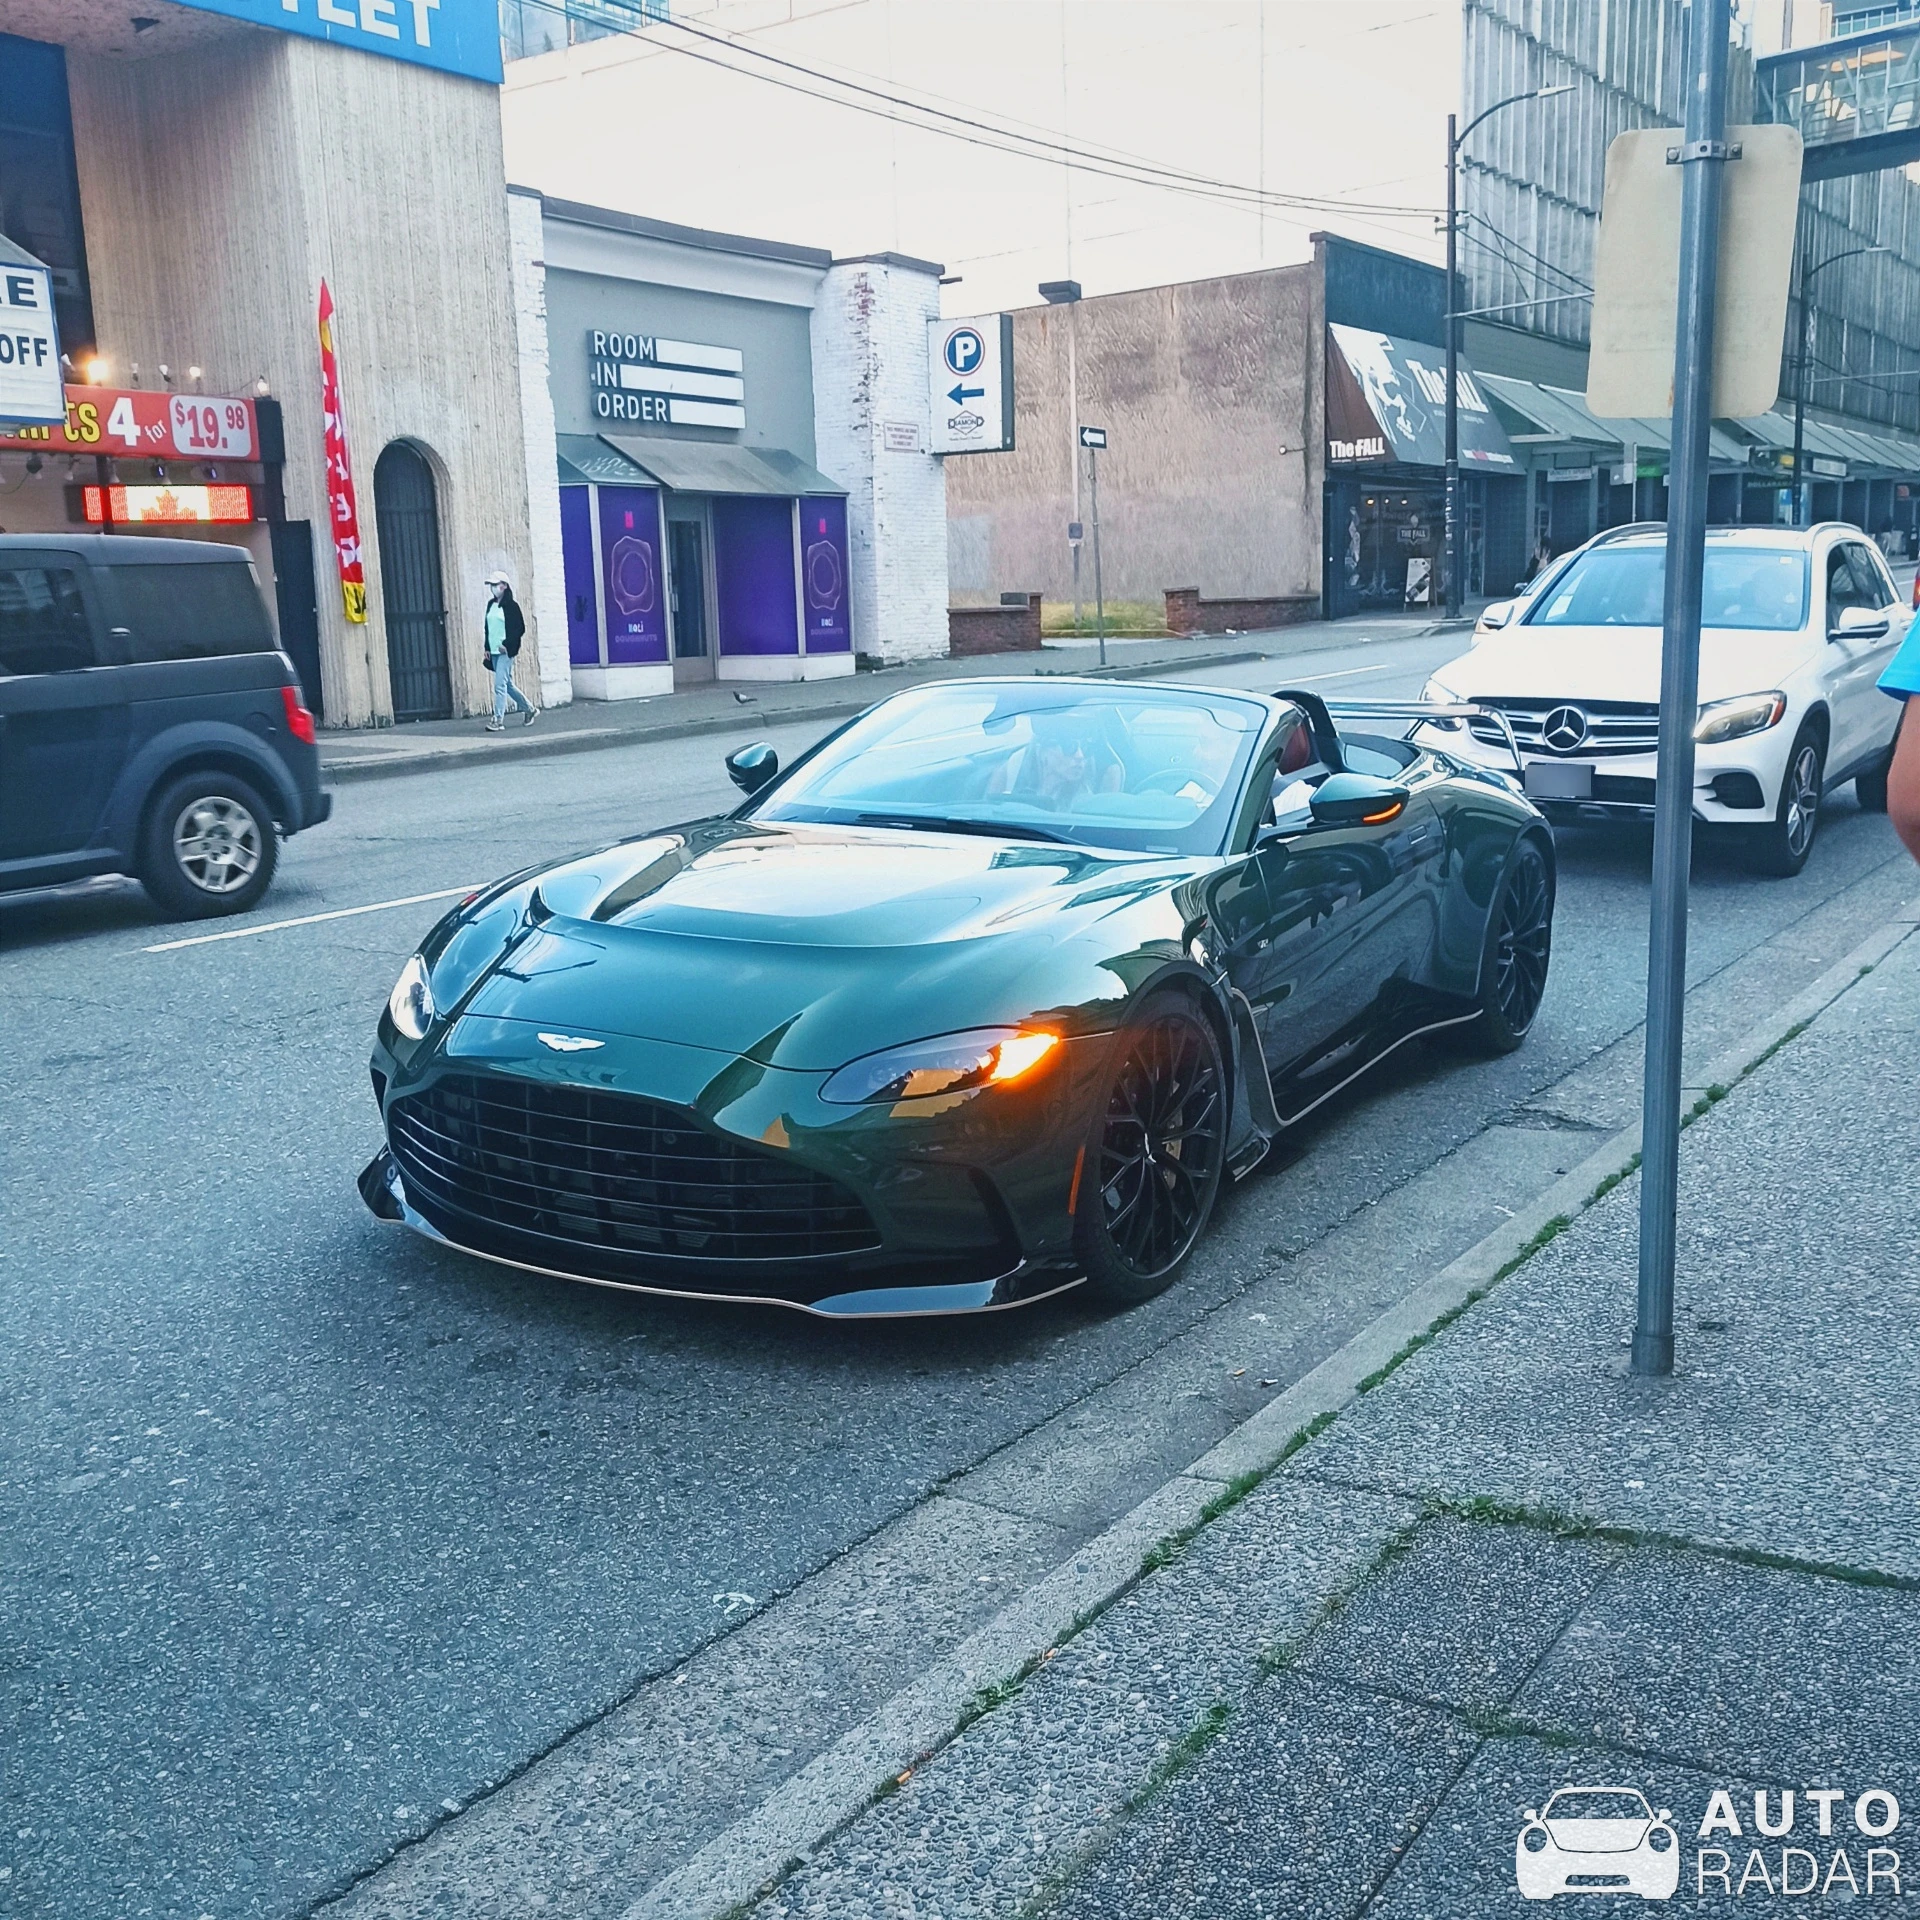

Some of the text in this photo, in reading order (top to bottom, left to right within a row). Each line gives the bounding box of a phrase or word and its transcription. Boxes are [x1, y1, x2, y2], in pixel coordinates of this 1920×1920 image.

[0, 275, 37, 307] E
[0, 333, 48, 367] OFF
[593, 330, 654, 361] ROOM
[955, 336, 977, 368] P
[596, 361, 618, 388] IN
[107, 397, 141, 446] 4
[145, 419, 167, 443] for
[598, 392, 667, 422] ORDER
[1329, 436, 1385, 458] The FALL
[1401, 529, 1411, 538] THE
